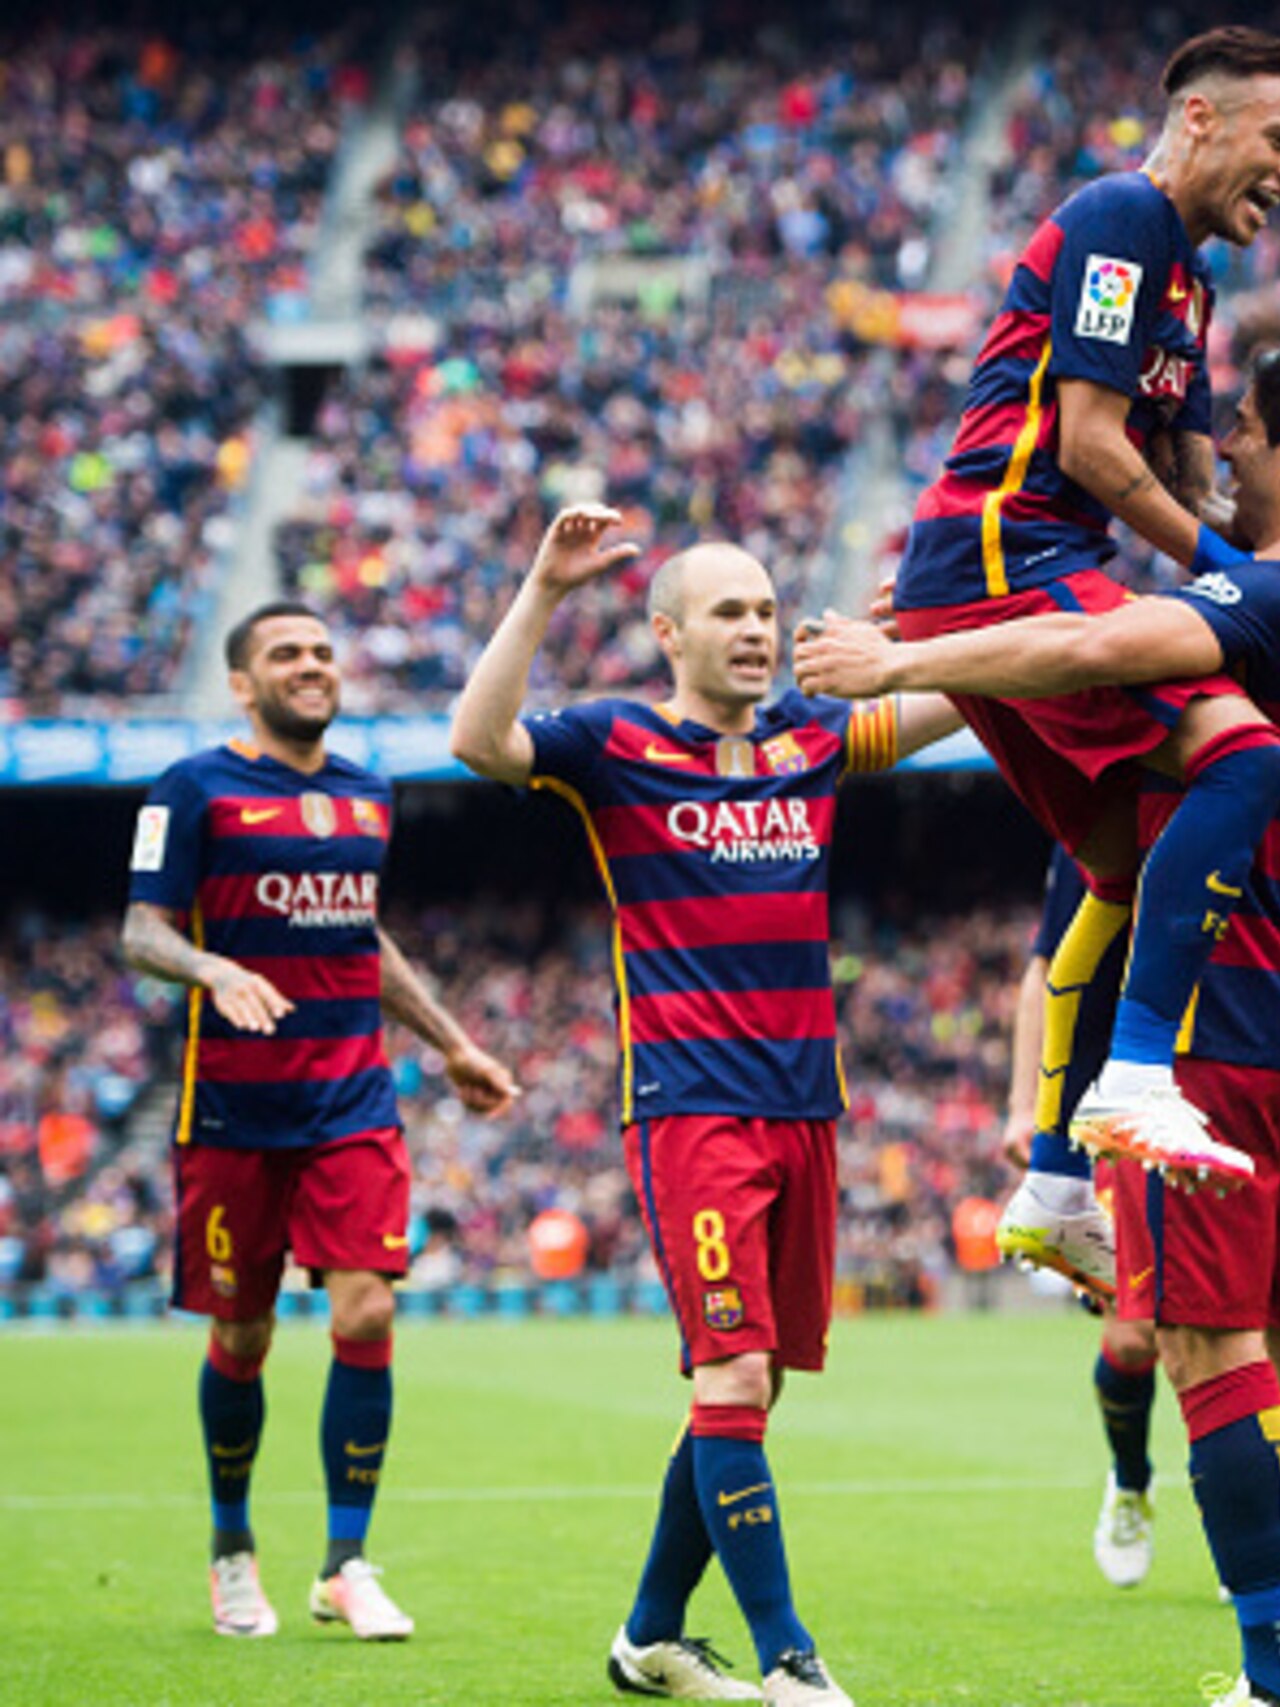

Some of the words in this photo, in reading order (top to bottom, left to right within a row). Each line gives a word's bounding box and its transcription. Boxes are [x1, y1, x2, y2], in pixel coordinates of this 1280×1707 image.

[1082, 309, 1126, 336] LFP
[667, 799, 811, 847] QATAR
[710, 835, 821, 864] AIRWAYS
[256, 873, 378, 915] QATAR
[206, 1207, 232, 1260] 6
[693, 1209, 731, 1281] 8
